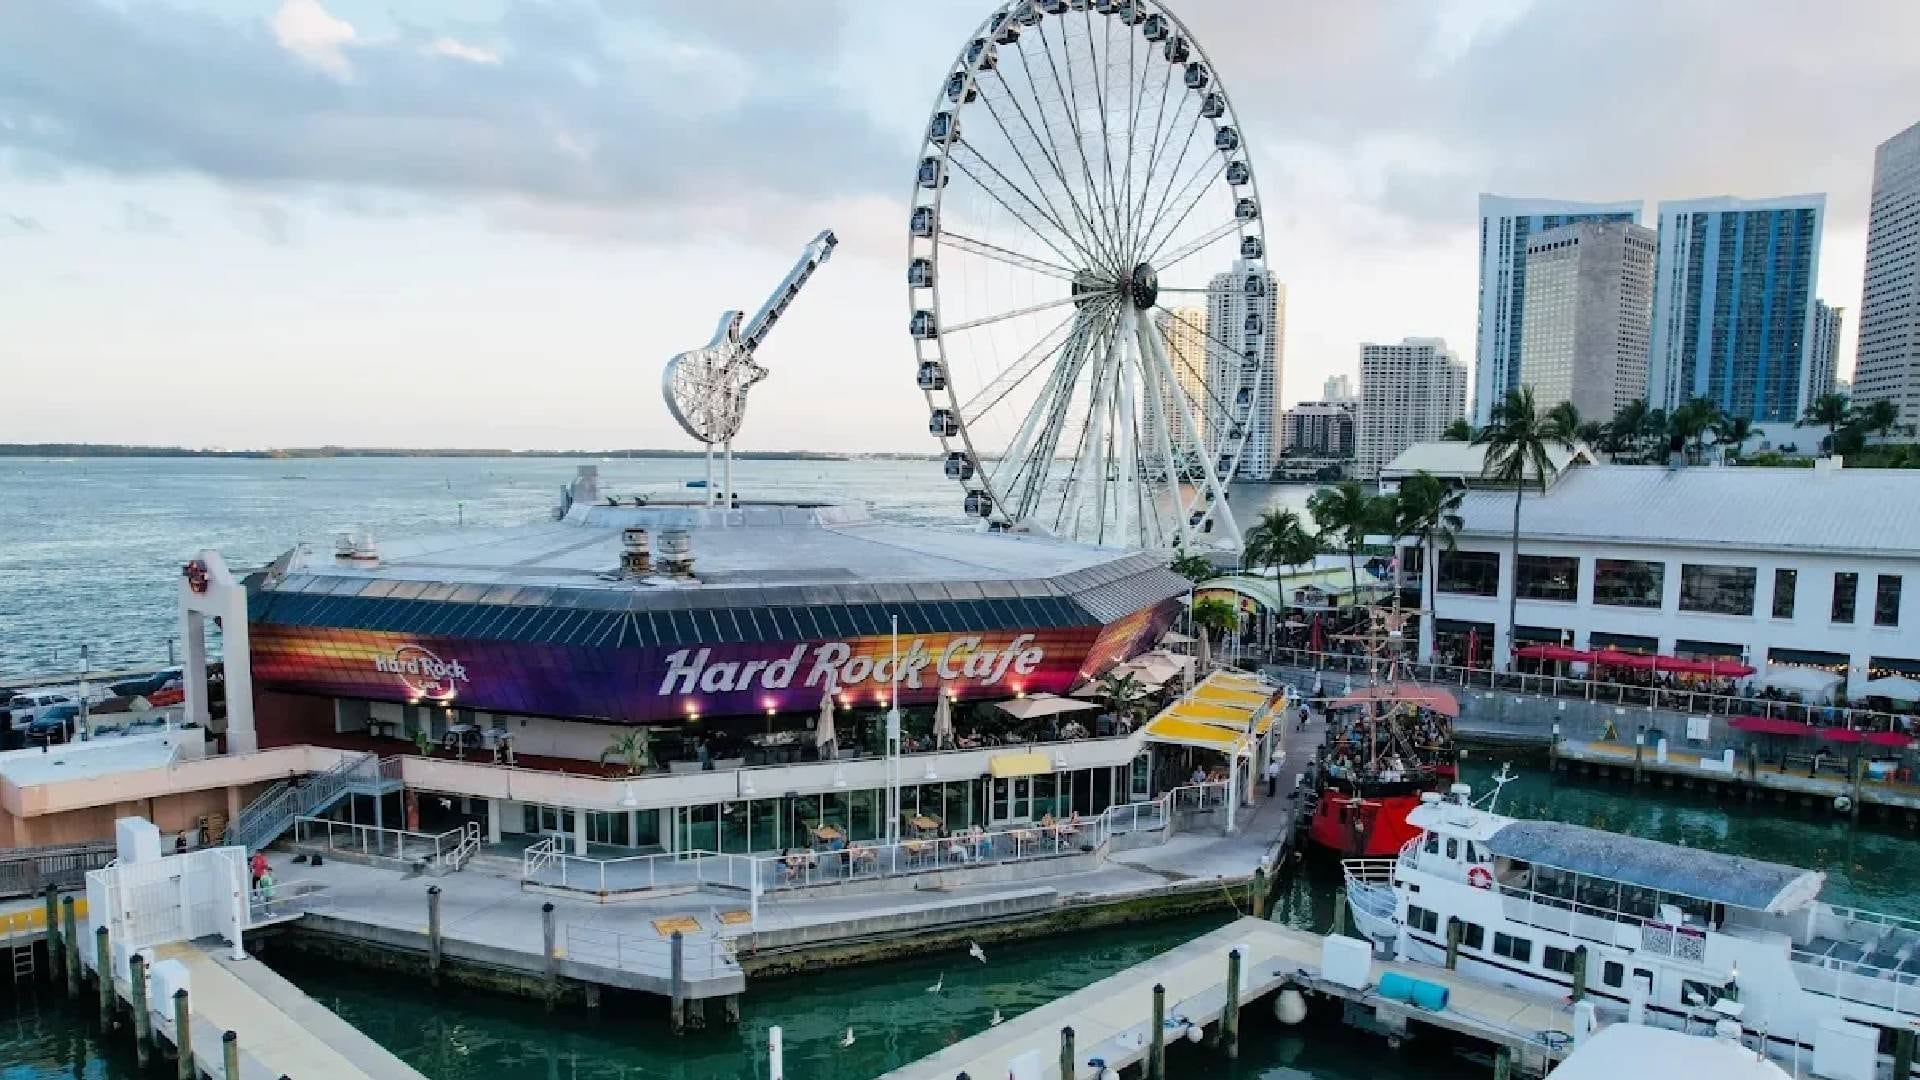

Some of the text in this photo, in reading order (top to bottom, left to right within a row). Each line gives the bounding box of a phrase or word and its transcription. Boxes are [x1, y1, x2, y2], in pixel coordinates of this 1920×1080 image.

[375, 655, 470, 682] Hard Rock
[658, 633, 1044, 696] Hard Rock Cafe
